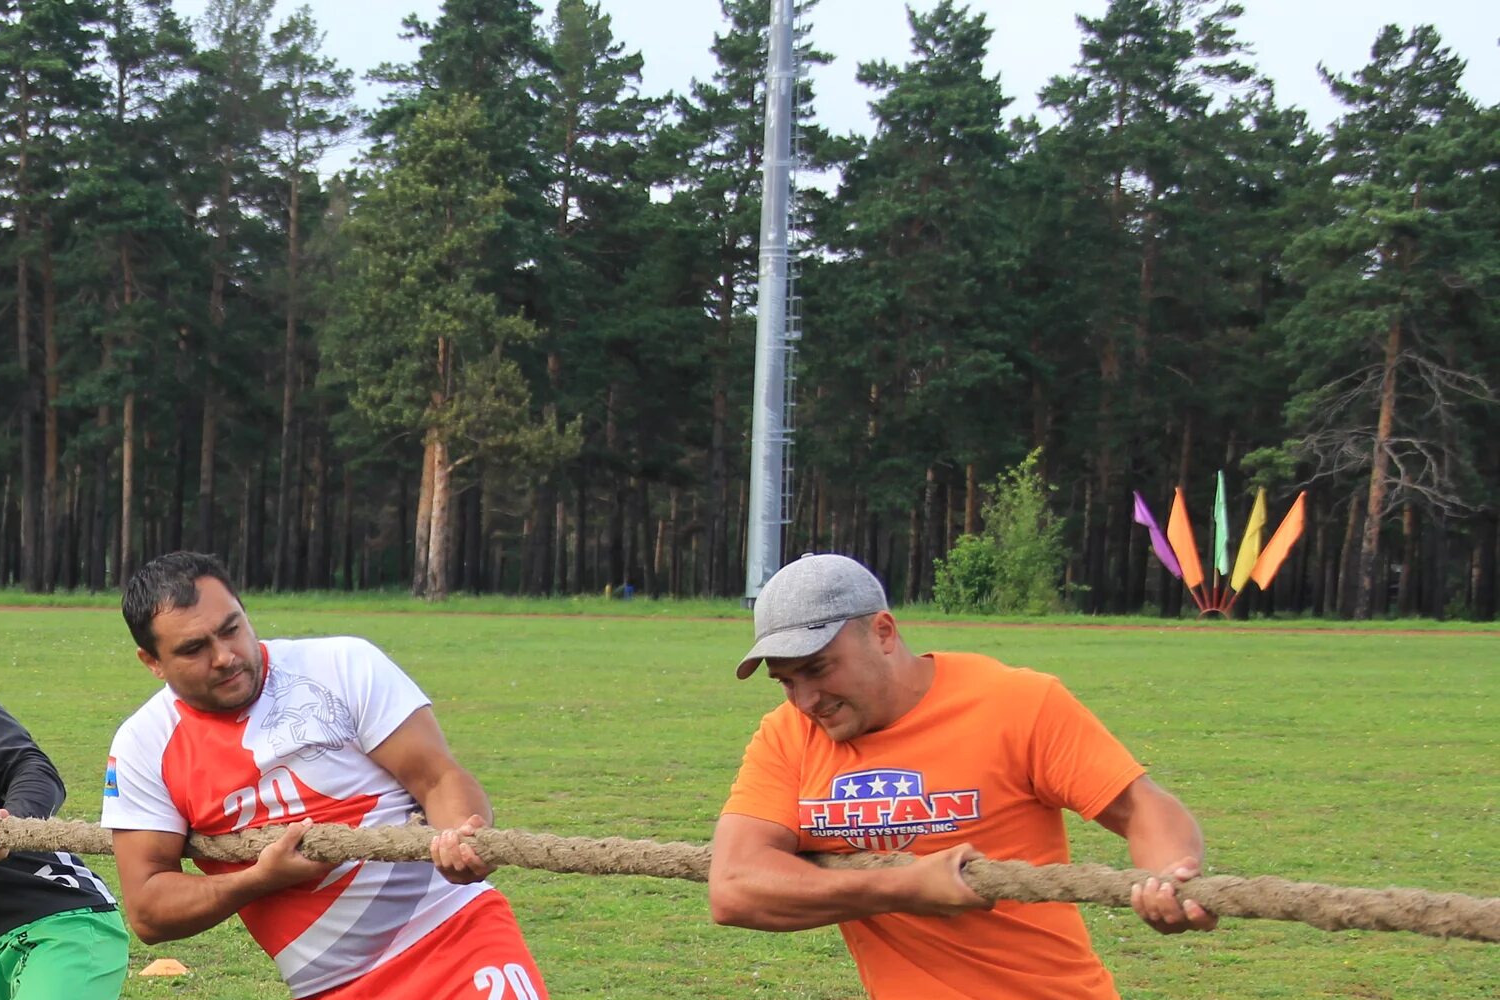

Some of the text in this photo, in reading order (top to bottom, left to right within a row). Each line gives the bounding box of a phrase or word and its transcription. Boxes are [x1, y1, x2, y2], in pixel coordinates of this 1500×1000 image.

[799, 792, 978, 828] TITAN
[811, 823, 957, 838] SUPPORT SYSTEMS, INC.
